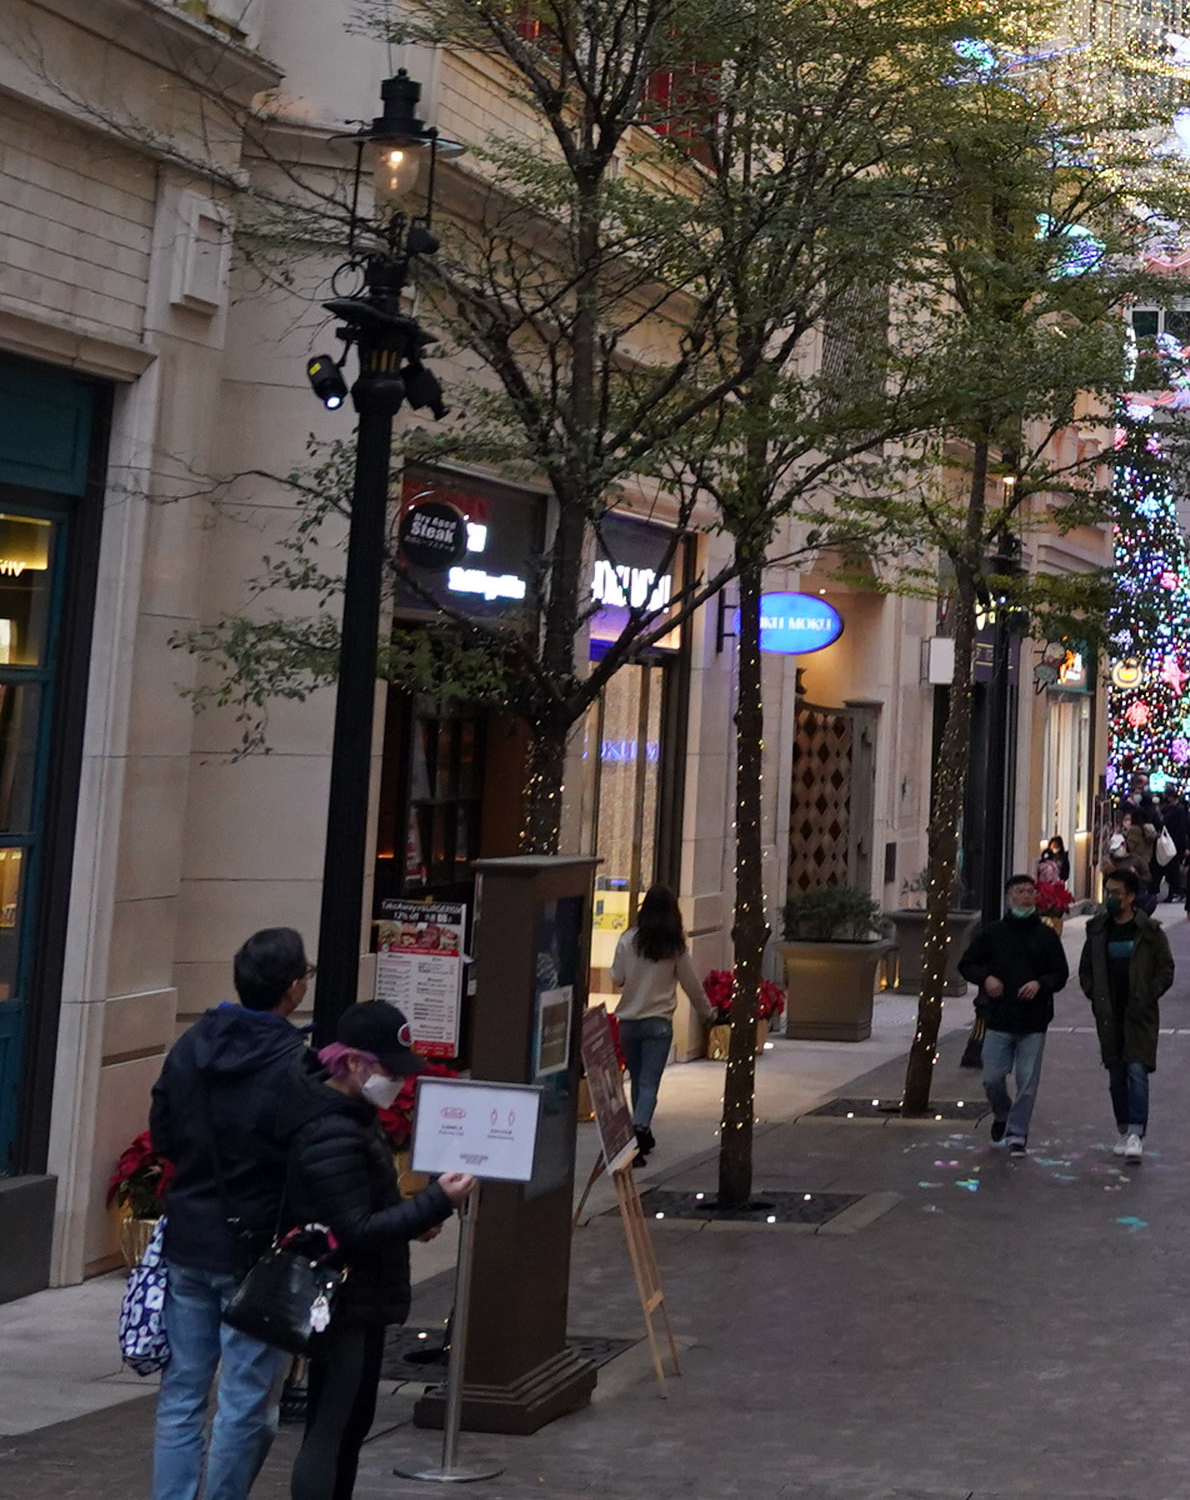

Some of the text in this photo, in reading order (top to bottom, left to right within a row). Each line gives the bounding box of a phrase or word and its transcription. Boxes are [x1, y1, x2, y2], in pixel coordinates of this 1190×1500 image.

[410, 520, 455, 543] Steak
[760, 616, 832, 631] OKU MOKU
